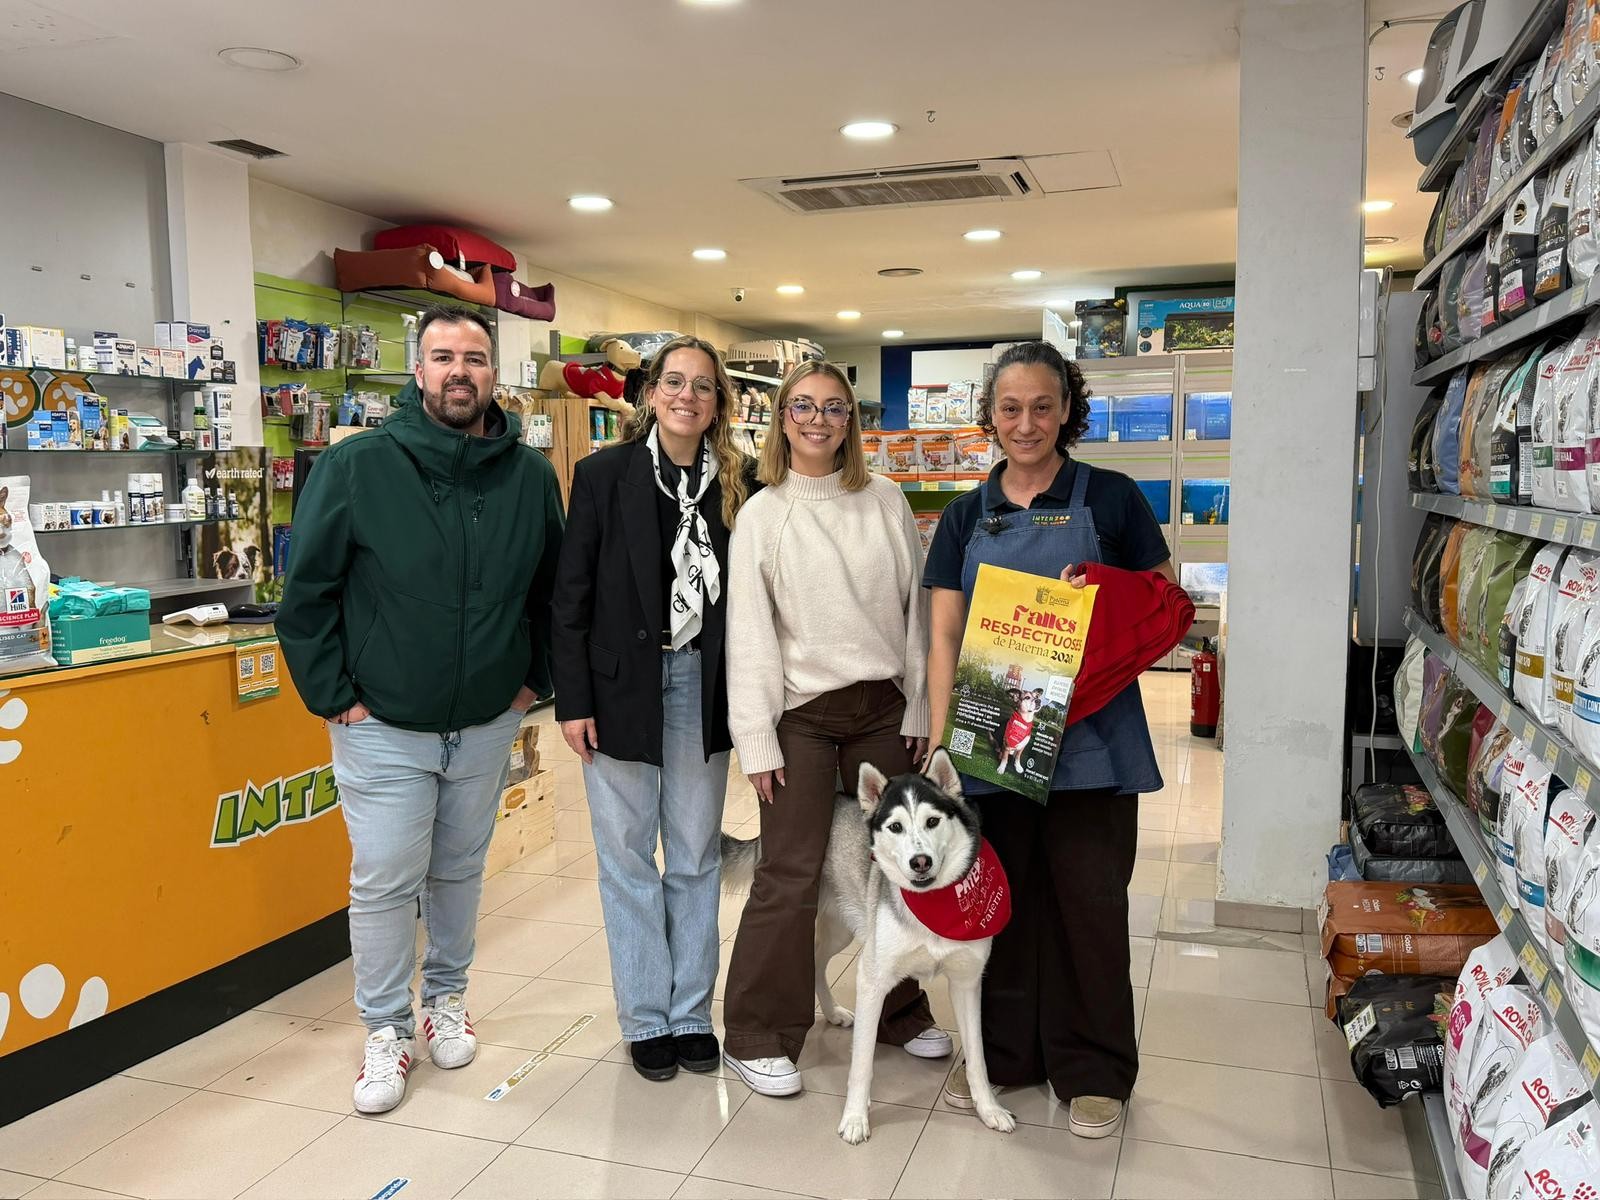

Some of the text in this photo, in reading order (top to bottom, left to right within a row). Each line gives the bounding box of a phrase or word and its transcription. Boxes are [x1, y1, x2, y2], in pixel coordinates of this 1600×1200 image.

[1179, 302, 1201, 310] AQUA
[216, 467, 263, 479] earth rated
[24, 611, 39, 619] PLAN
[1012, 604, 1077, 635] Falles
[99, 635, 126, 646] freedog
[980, 617, 1083, 652] RESPECTUOSES
[992, 635, 1007, 647] de
[1008, 638, 1050, 658] Paterna
[211, 762, 341, 847] INTE
[979, 886, 1004, 929] Paterna
[1404, 934, 1413, 954] Gosbi
[1470, 964, 1491, 992] ROYAL
[1502, 1005, 1528, 1036] ROYAL
